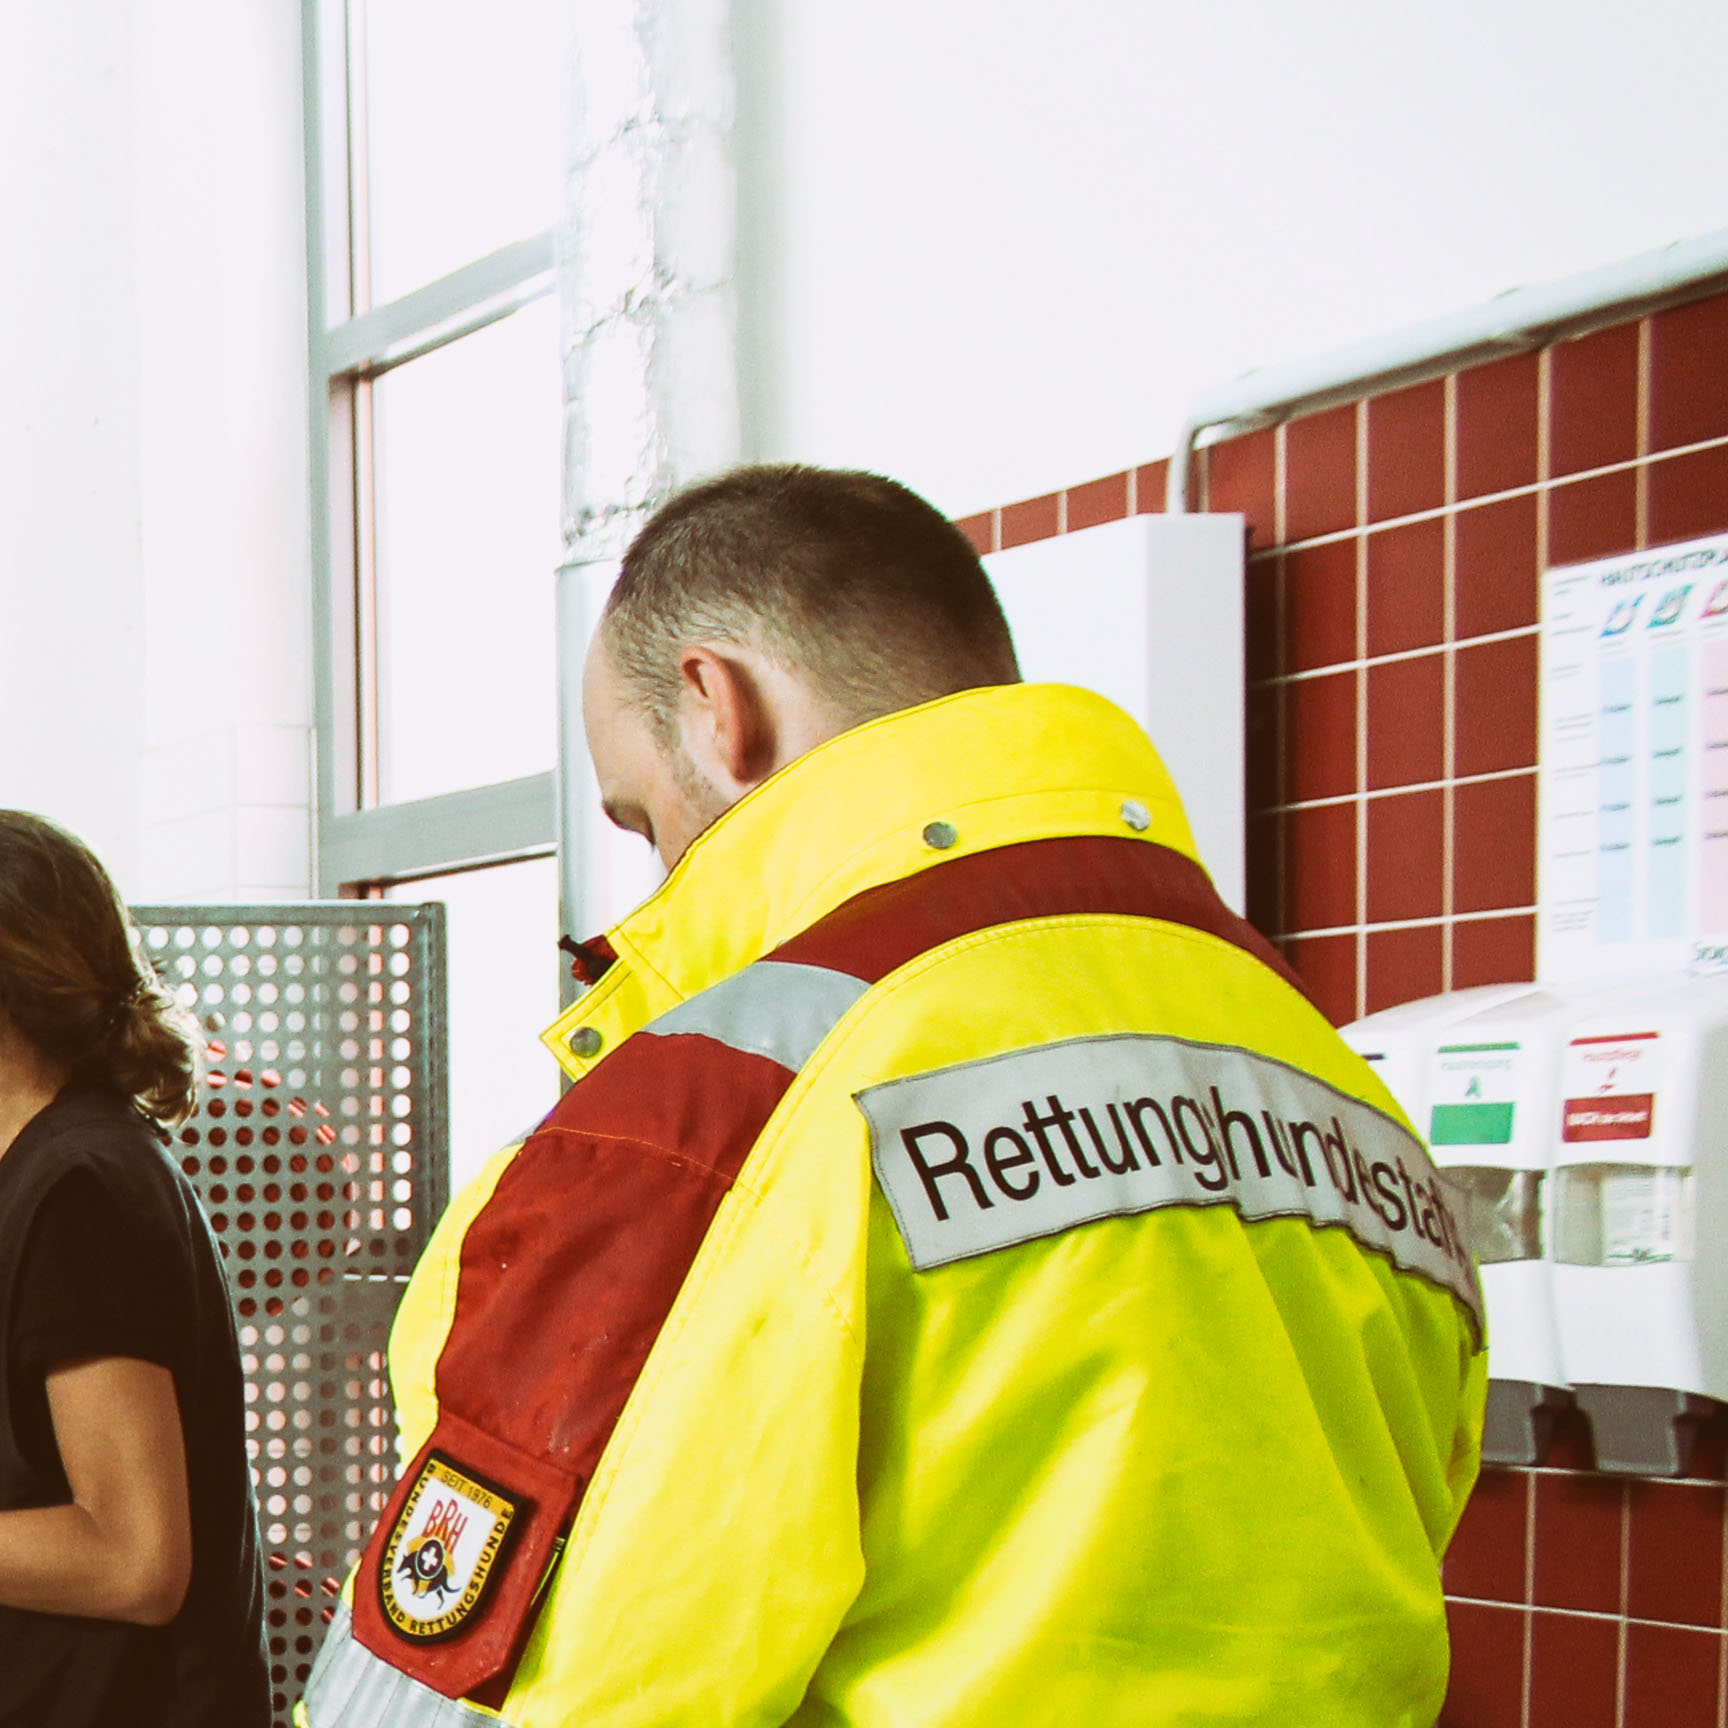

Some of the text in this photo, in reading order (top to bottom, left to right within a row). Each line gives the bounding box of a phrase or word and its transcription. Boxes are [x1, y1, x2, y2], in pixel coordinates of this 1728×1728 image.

[441, 1470, 493, 1510] SEIT 1976
[382, 1462, 514, 1635] BUNDESVERBAND RETTUNGSHUNDE
[421, 1498, 469, 1556] BRH
